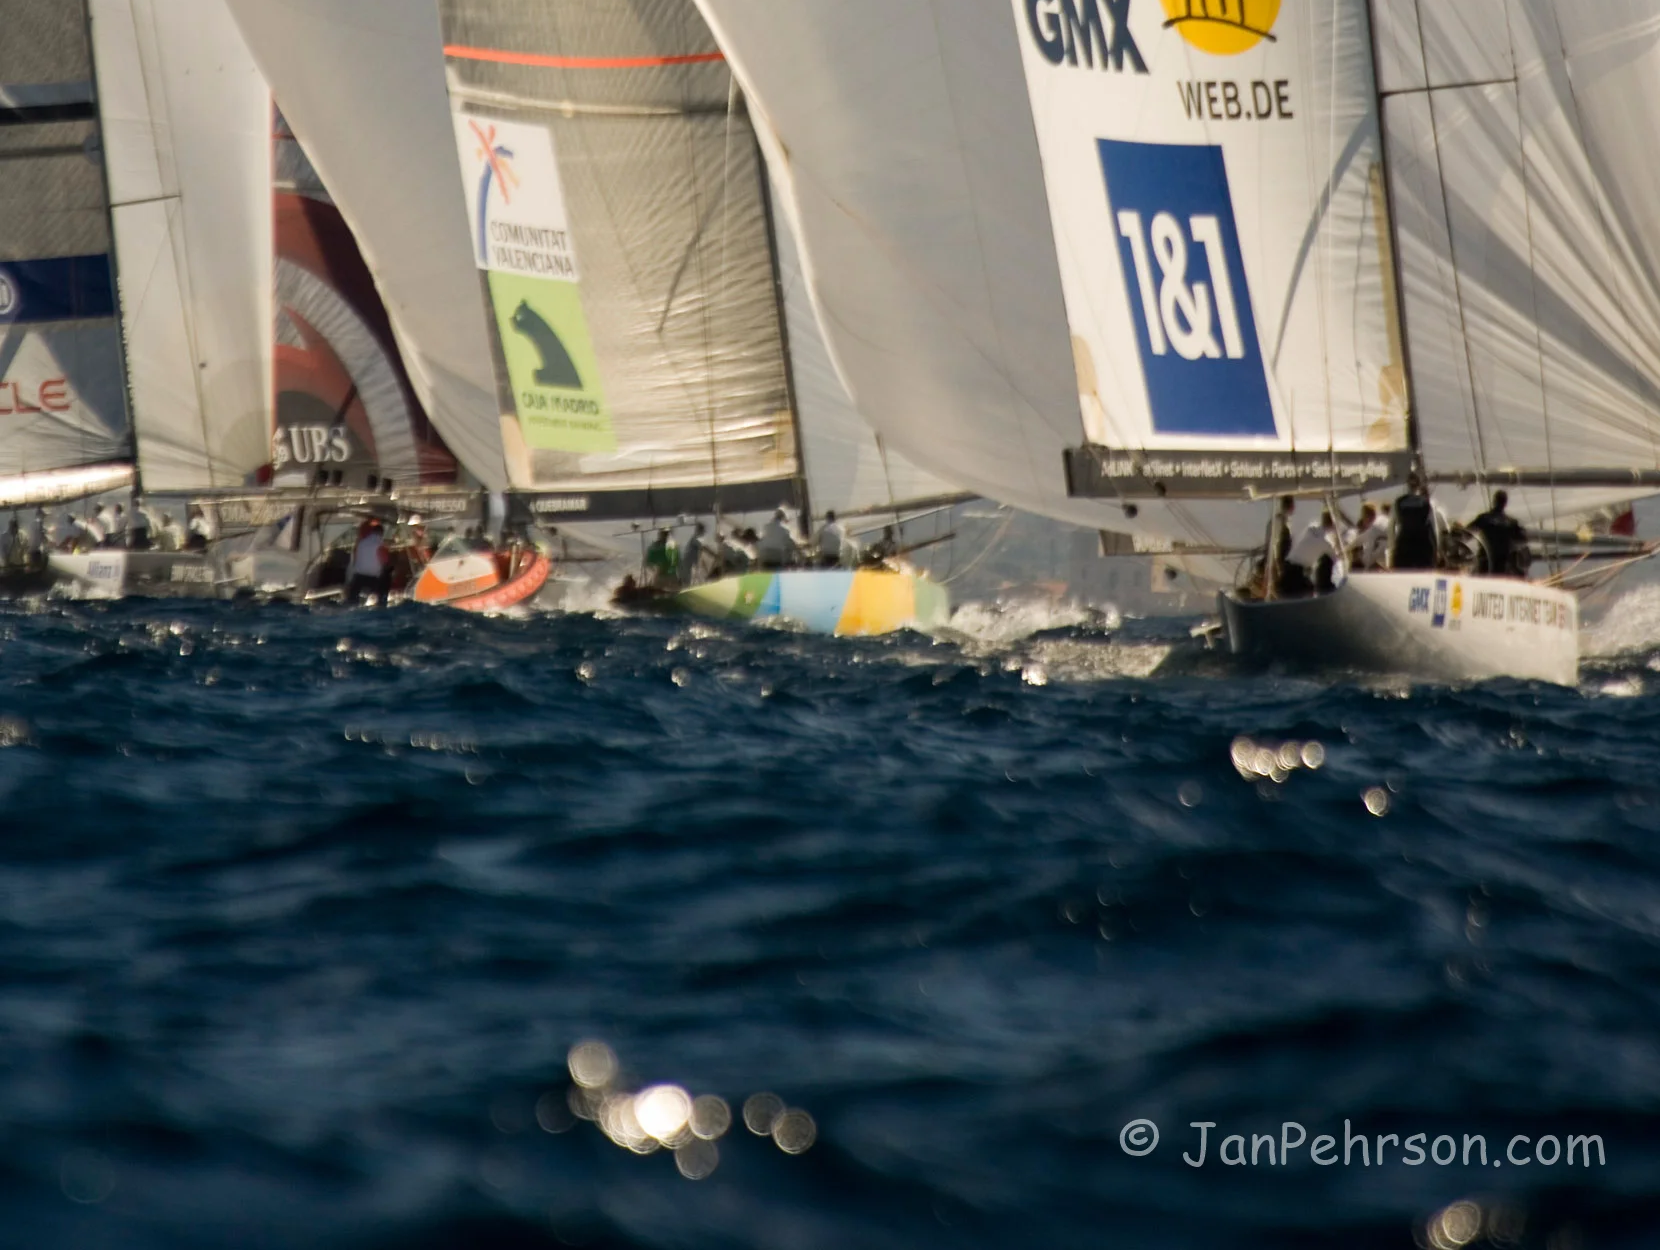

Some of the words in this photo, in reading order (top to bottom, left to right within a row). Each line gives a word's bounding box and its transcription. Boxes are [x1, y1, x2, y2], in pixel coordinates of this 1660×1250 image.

[1177, 79, 1294, 119] WEB.DE
[491, 221, 566, 250] COMUNITAT
[492, 246, 574, 277] VALENCIANA
[1117, 208, 1244, 360] 1&1
[292, 421, 352, 463] UBS
[1271, 461, 1304, 478] Partnr
